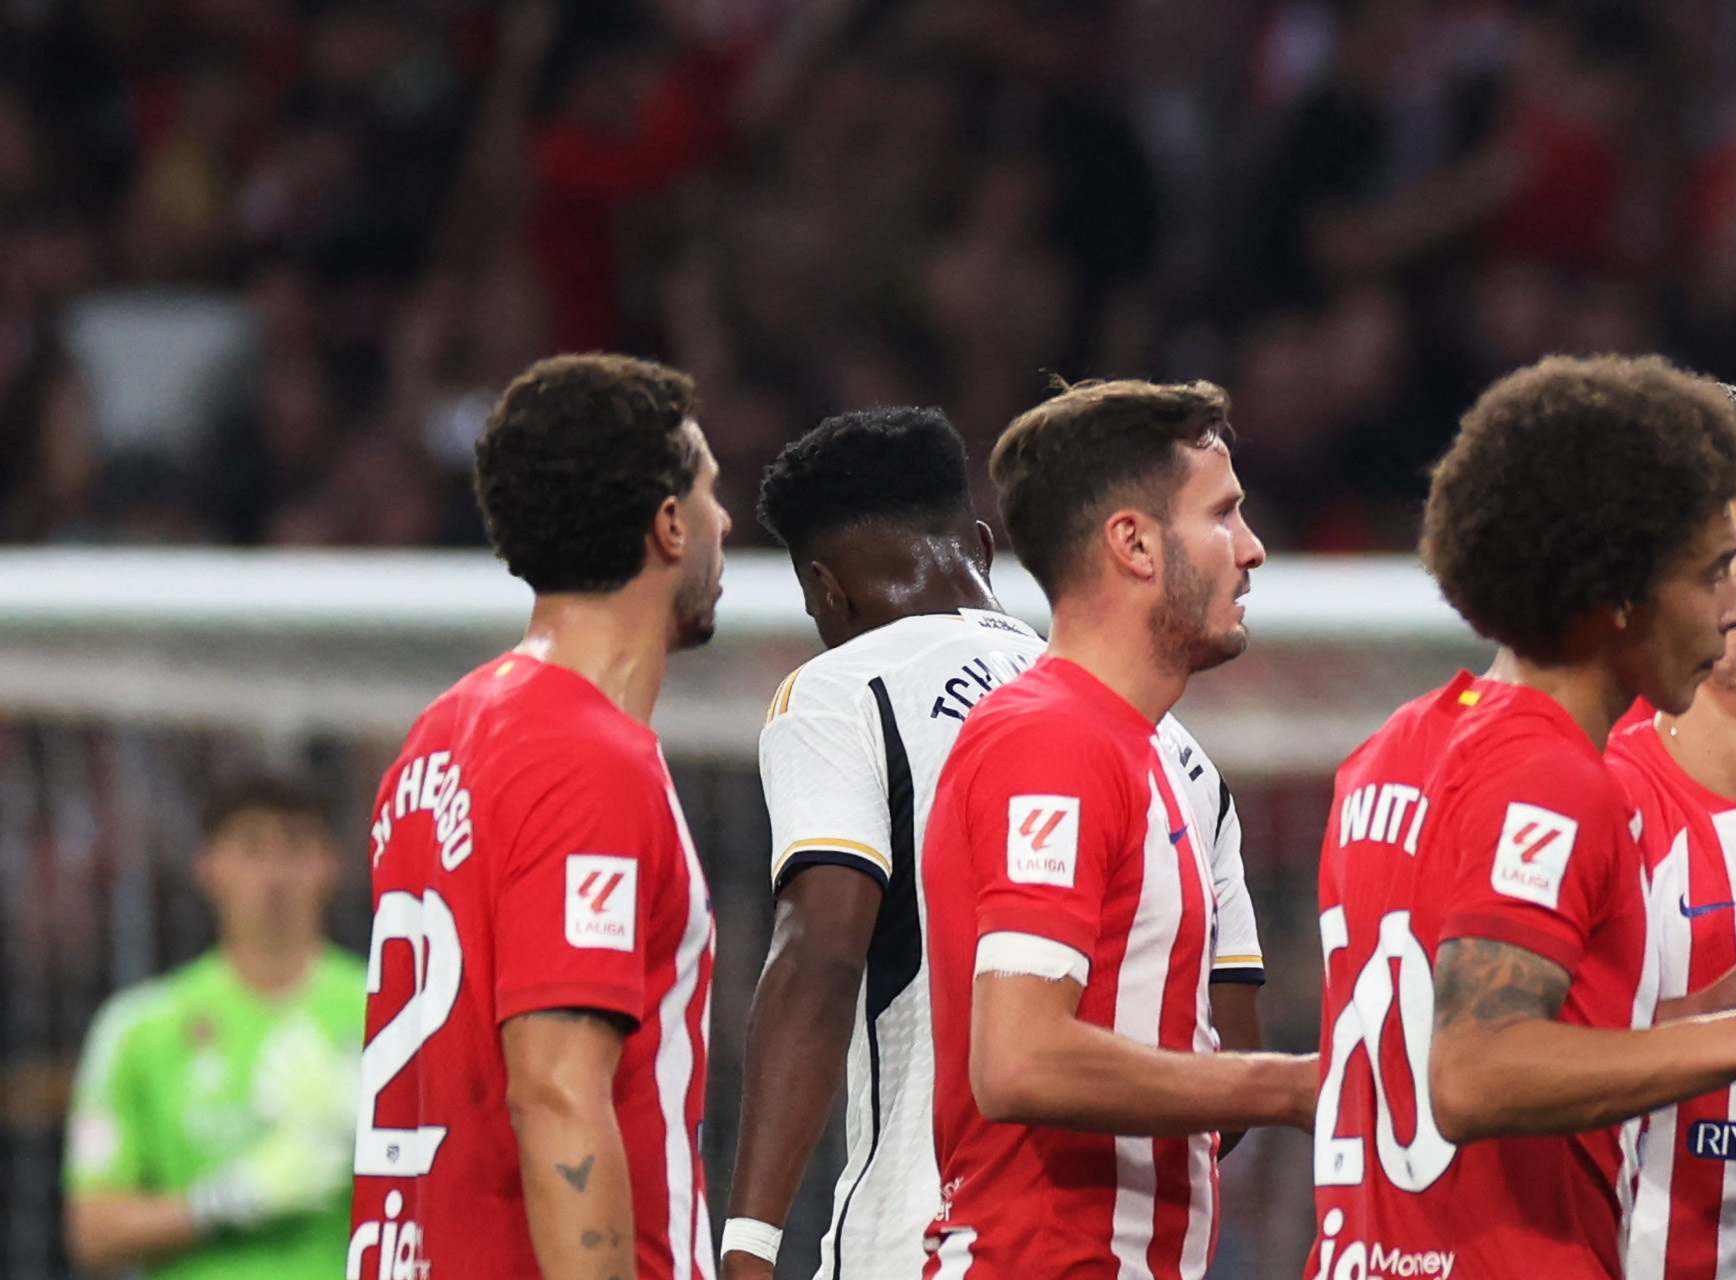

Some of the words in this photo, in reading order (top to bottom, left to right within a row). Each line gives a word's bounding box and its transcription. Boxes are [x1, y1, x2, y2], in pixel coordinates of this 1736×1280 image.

[1339, 782, 1429, 857] WIT
[1017, 858, 1066, 873] LALIGA
[576, 919, 625, 937] LALIGA
[1370, 1241, 1456, 1280] Money
